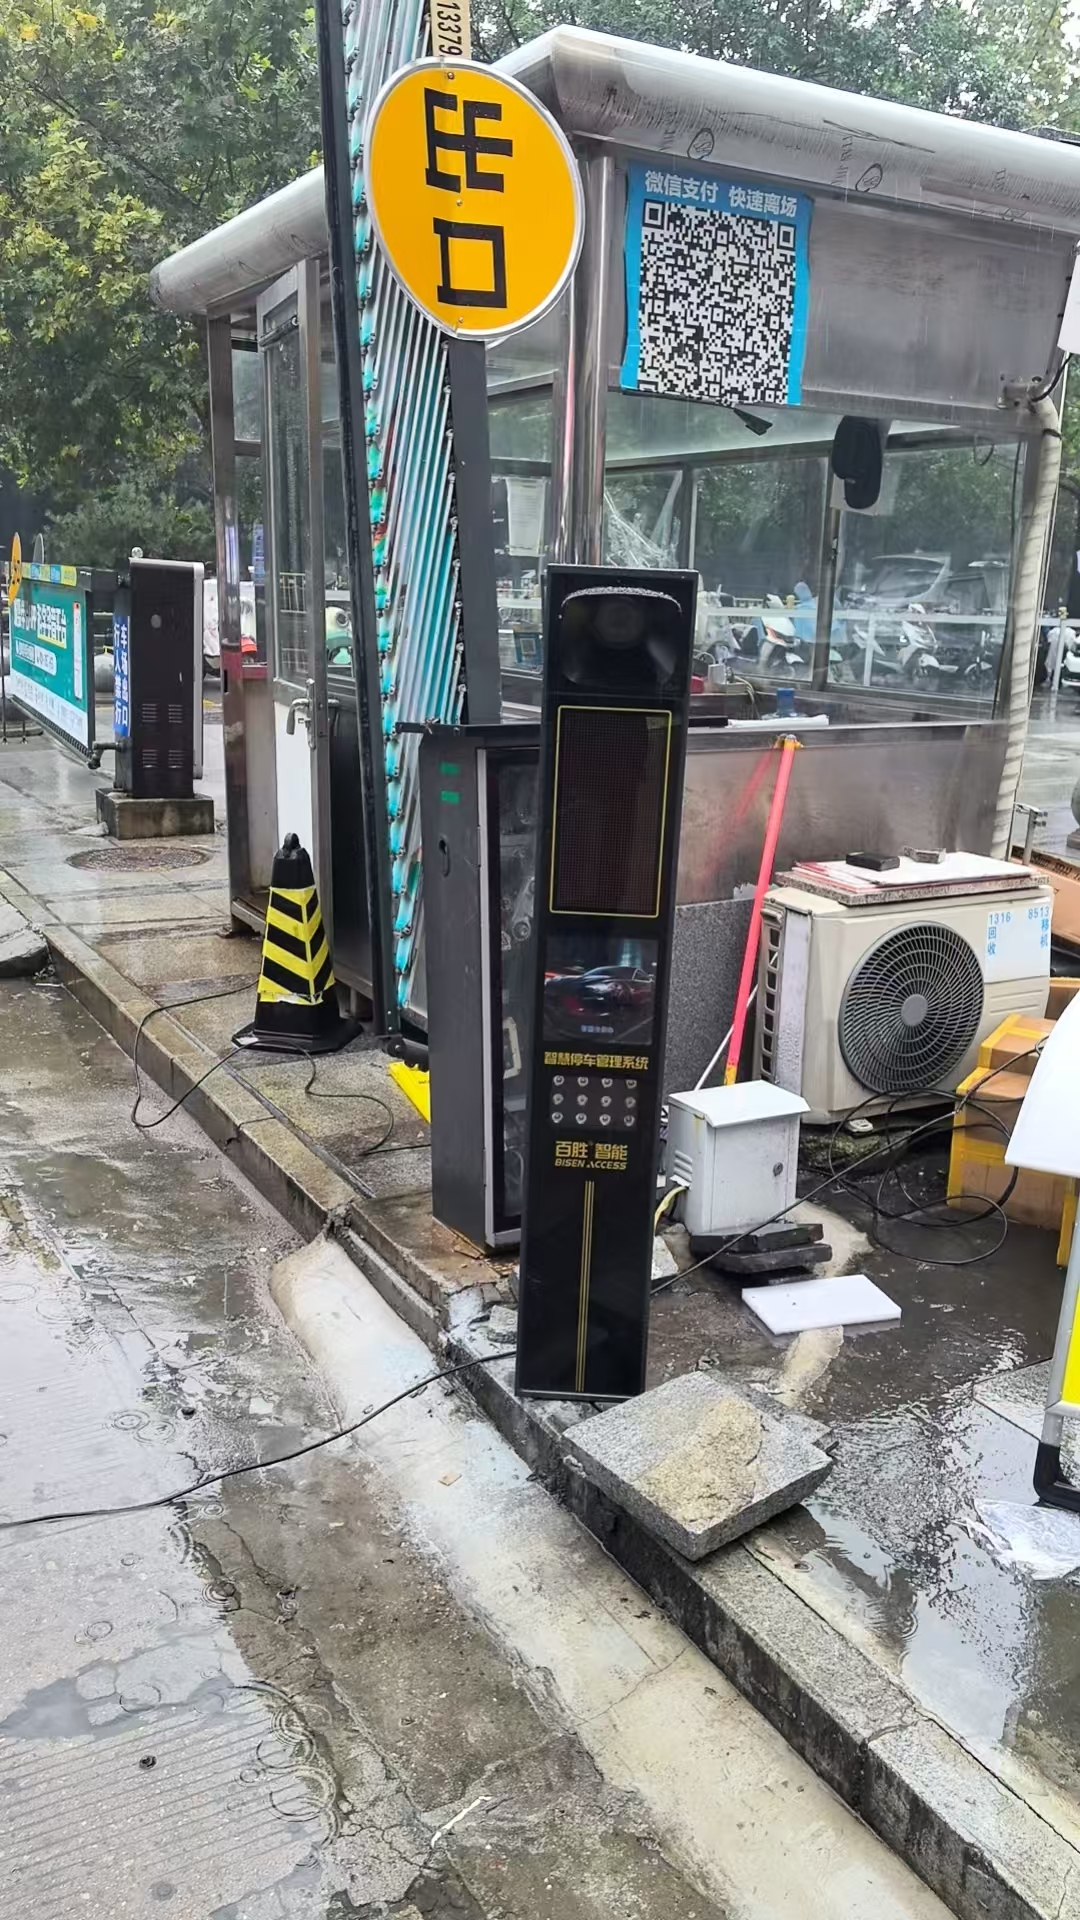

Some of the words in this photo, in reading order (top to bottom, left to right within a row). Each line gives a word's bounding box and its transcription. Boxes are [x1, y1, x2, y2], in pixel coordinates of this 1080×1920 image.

[437, 3, 463, 55] 13379
[424, 87, 513, 308] 出口
[645, 170, 719, 204] 微信支付
[728, 185, 798, 218] 快速离场
[989, 911, 1011, 925] 1316
[1028, 906, 1049, 920] 8513
[544, 1051, 649, 1070] 智慧停车管理系统
[555, 1141, 588, 1158] 百胜
[595, 1143, 628, 1161] 智能
[555, 1158, 585, 1168] BISEN
[586, 1161, 628, 1170] ACCESS
